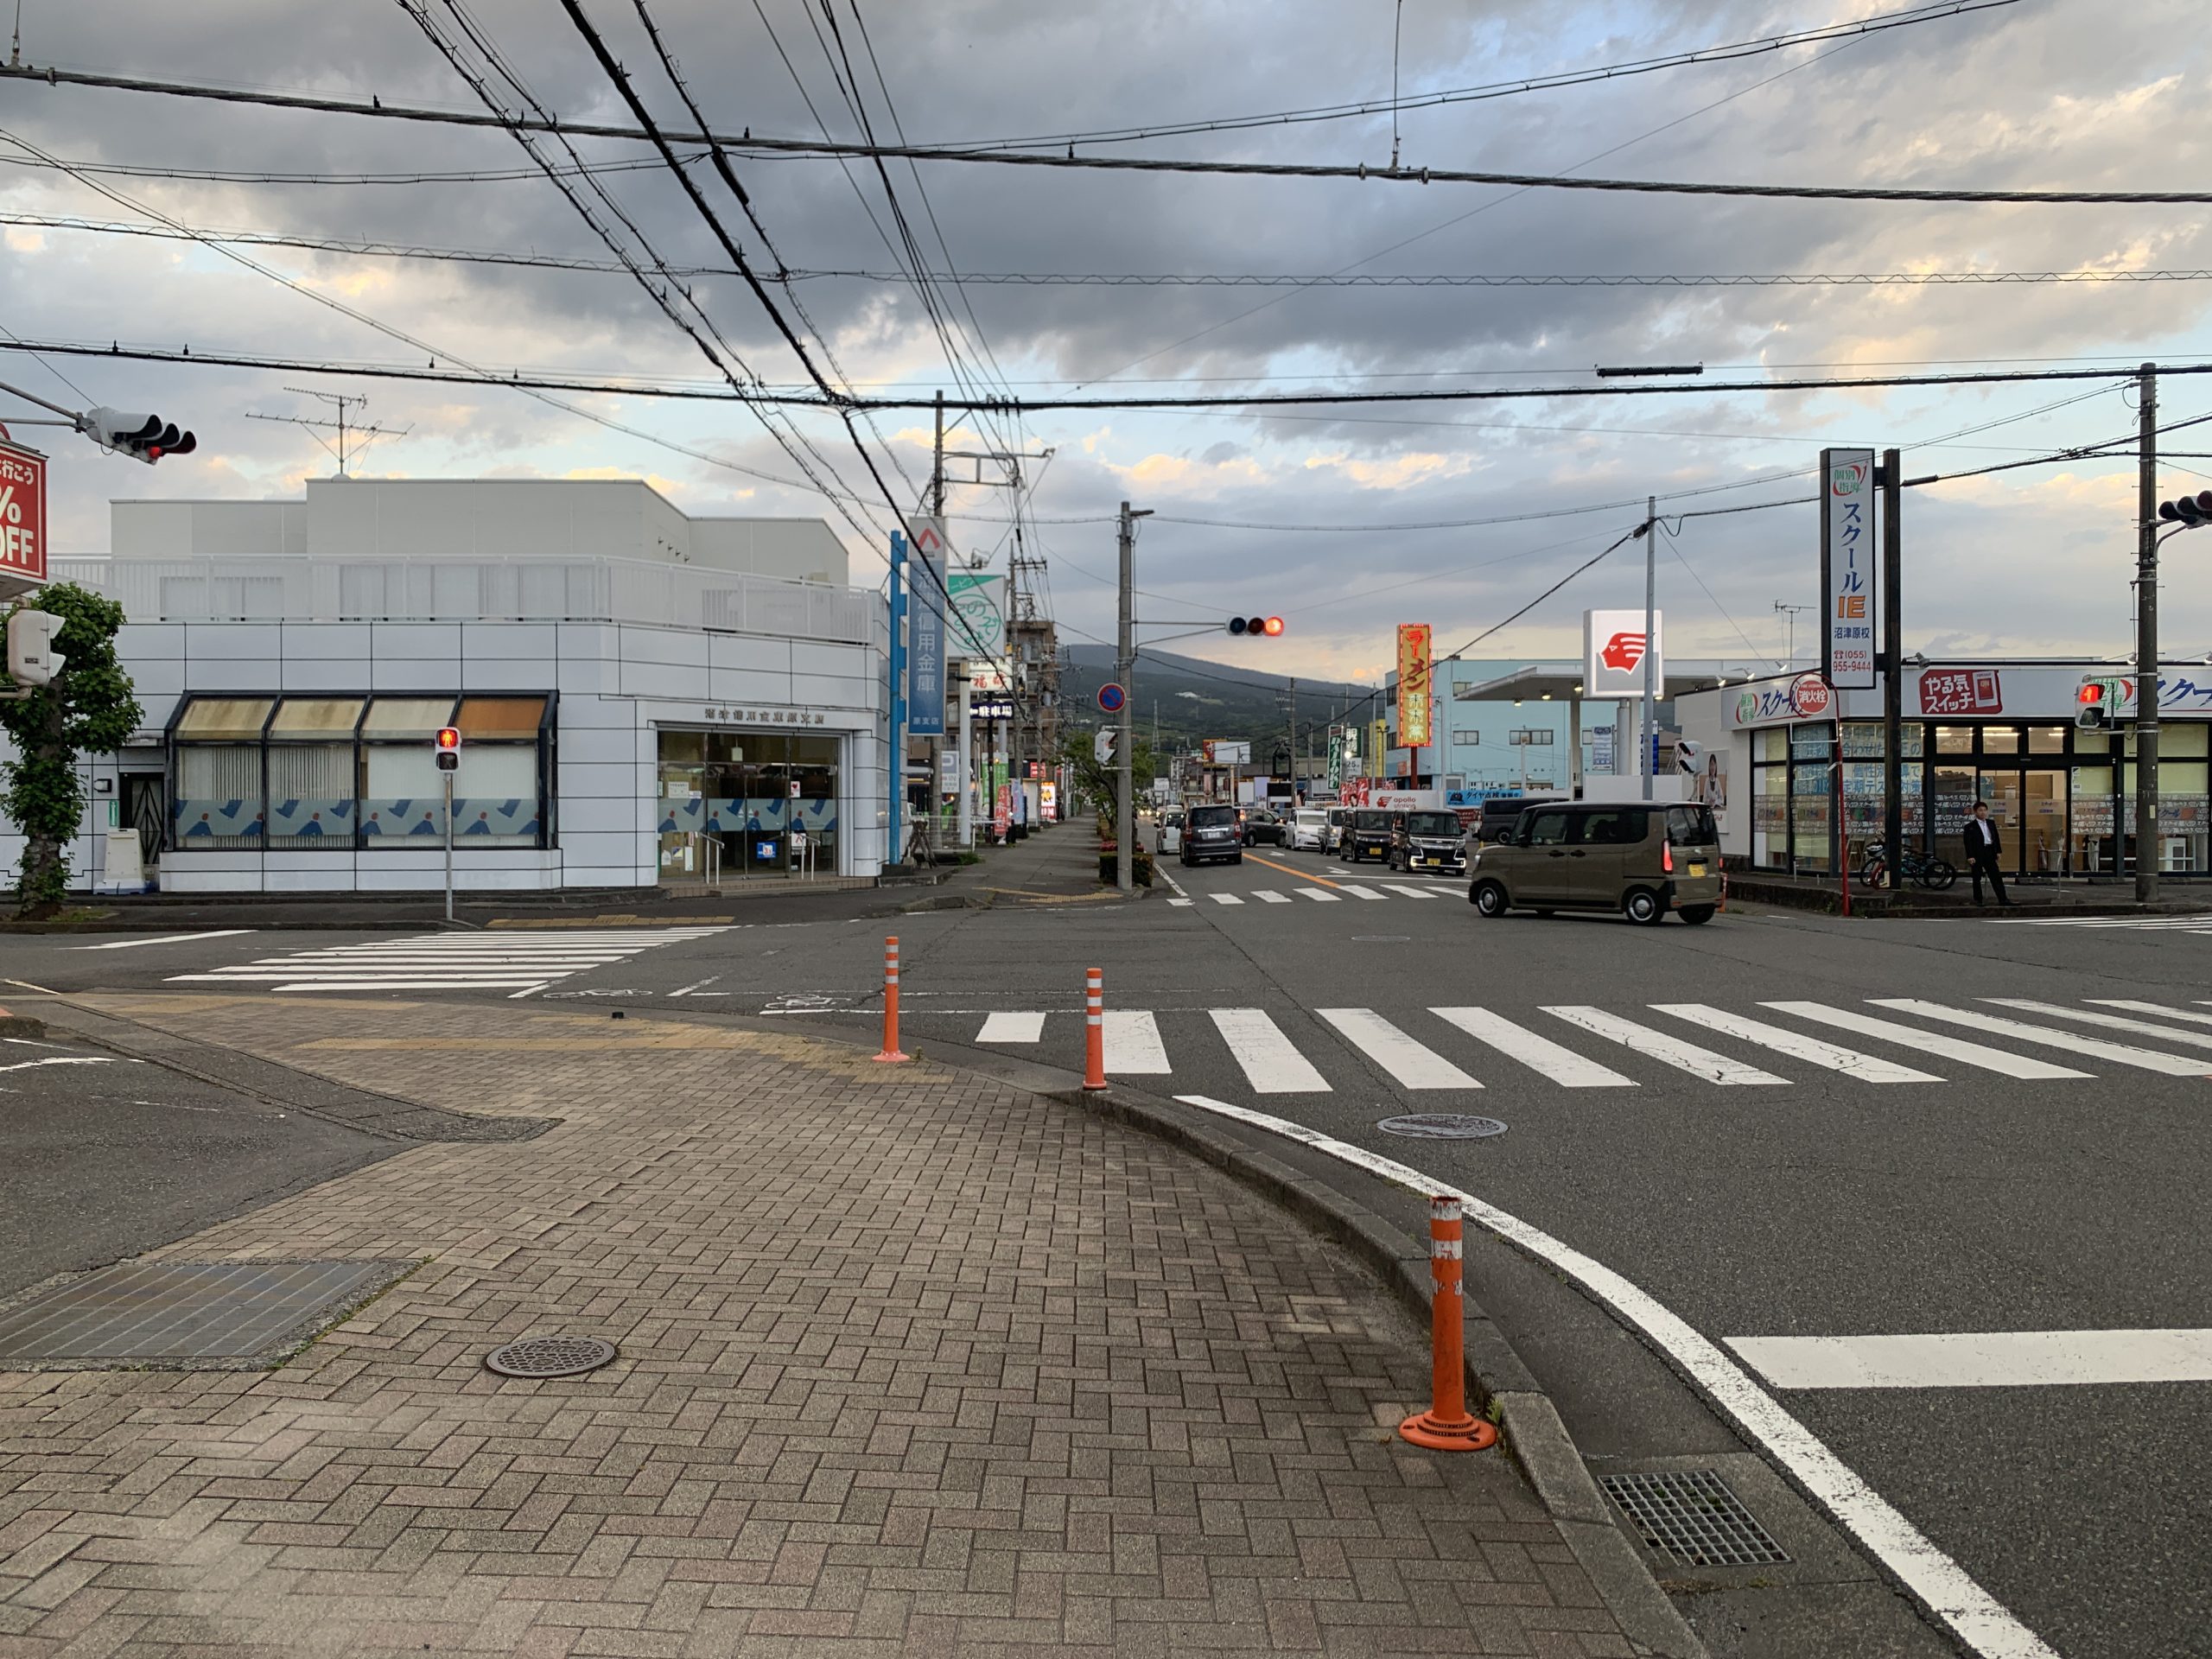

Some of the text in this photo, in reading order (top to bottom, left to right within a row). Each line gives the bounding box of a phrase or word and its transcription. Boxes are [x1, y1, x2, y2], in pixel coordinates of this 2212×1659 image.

[1834, 626, 1870, 639] 沼津原校
[1833, 661, 1871, 671] 955-9444
[1925, 674, 1970, 696] やる気
[1798, 690, 1827, 703] 消火栓
[1925, 692, 1974, 714] スイッチ
[912, 716, 940, 726] 原支店
